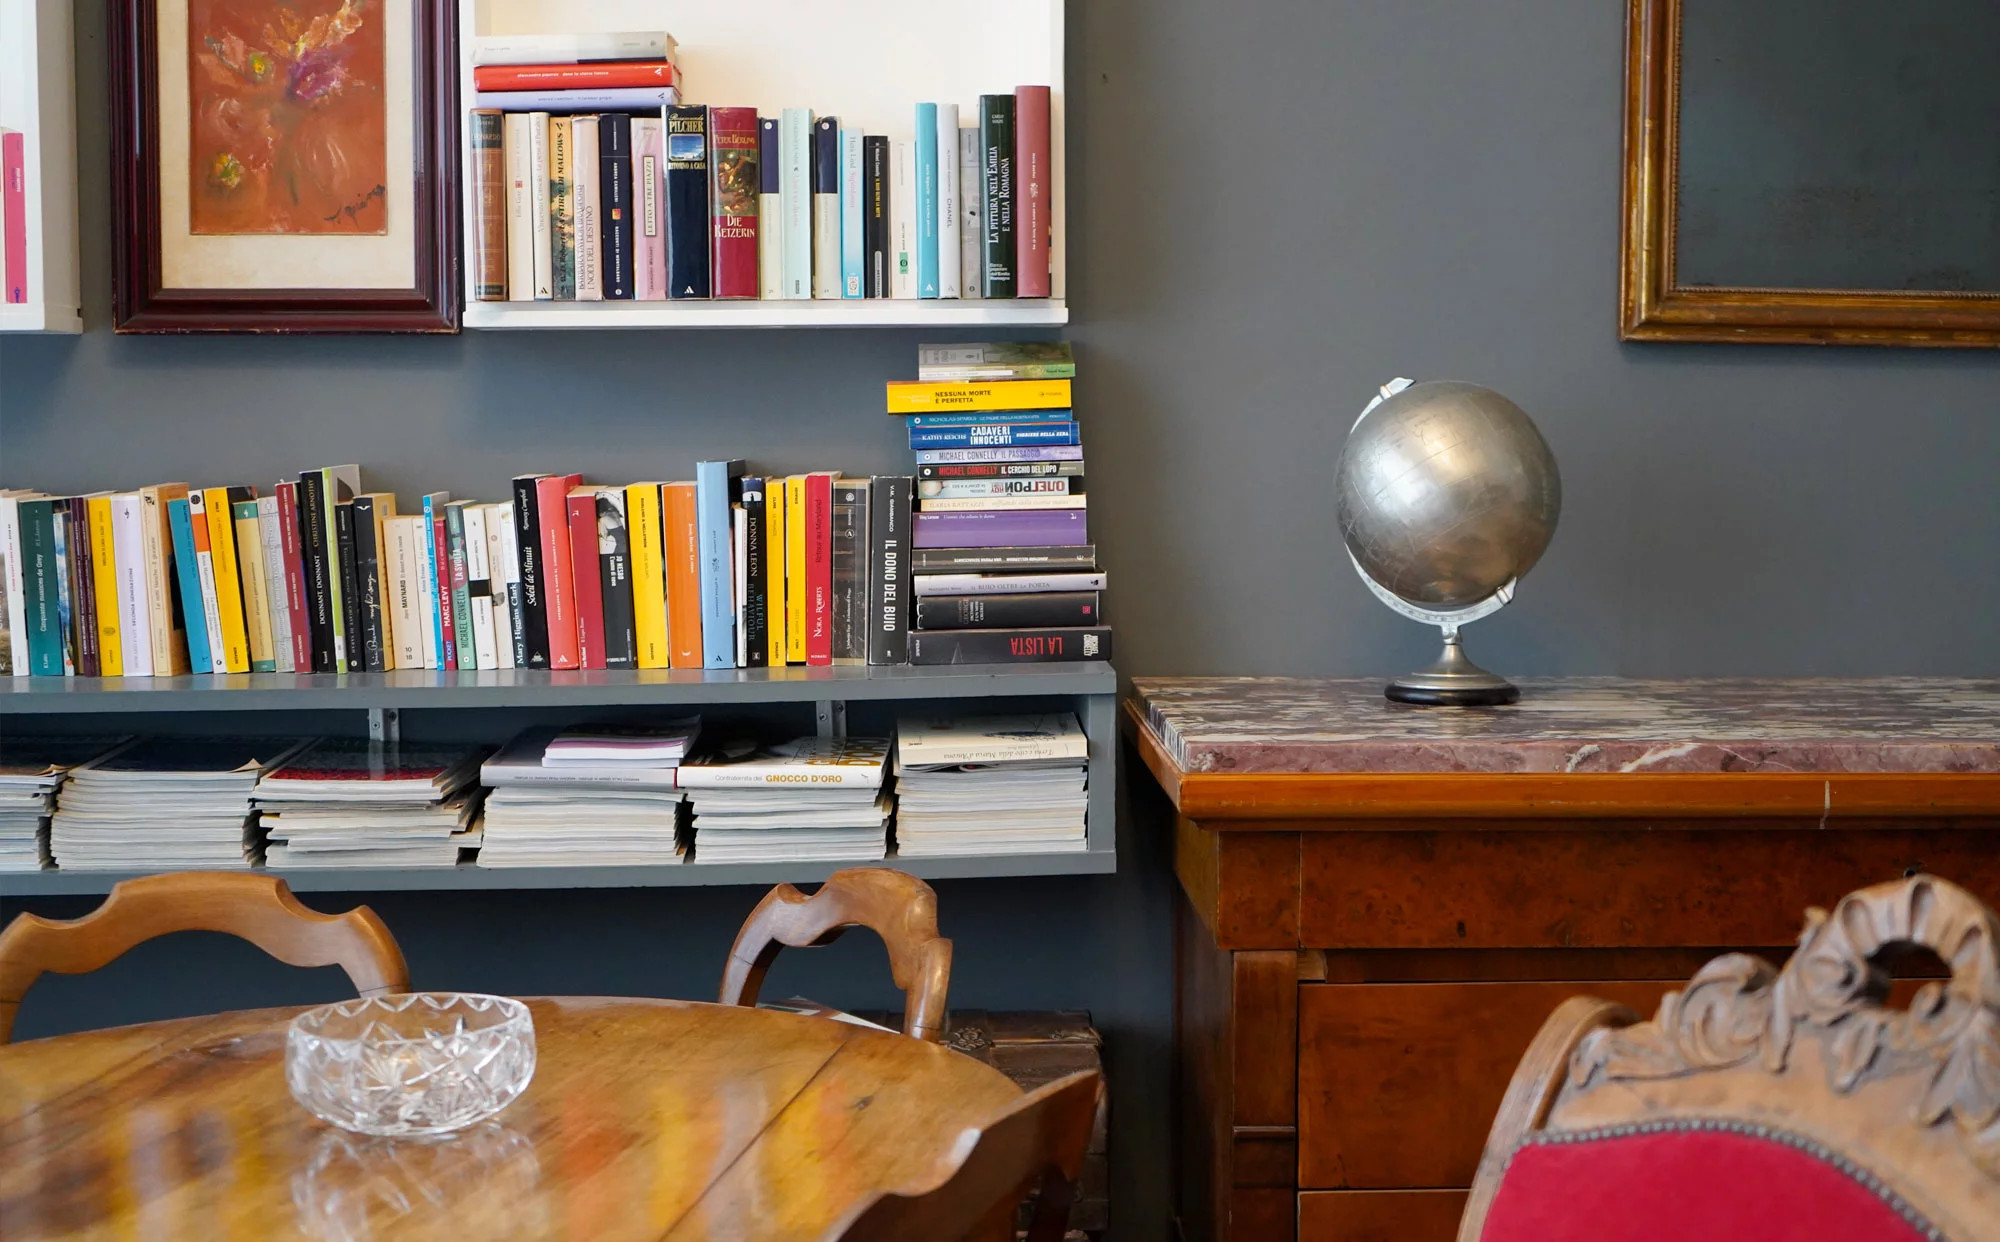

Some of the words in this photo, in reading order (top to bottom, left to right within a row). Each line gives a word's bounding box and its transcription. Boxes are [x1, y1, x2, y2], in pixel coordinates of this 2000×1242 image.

[668, 120, 704, 133] PILCHER
[557, 175, 564, 185] DI
[645, 159, 653, 185] PIAZZE
[986, 146, 998, 195] NELL'EMILIA
[999, 157, 1010, 199] ROMAGNA
[646, 208, 654, 233] LETTO
[727, 213, 743, 227] DIE
[989, 198, 998, 230] PITTURA
[1001, 201, 1010, 224] NELLA
[586, 206, 594, 243] DESTINO
[714, 227, 755, 238] KETZERIN
[988, 233, 999, 244] LA
[587, 264, 595, 284] NODI
[970, 426, 1010, 436] CADAVERI
[970, 435, 1012, 446] INNOCENTI
[938, 451, 965, 461] MICHAEL
[967, 450, 998, 460] CONNELLY
[1001, 450, 1006, 459] IL
[1008, 448, 1041, 459] PASSAGGIO
[938, 466, 964, 476] MICHAEL
[967, 466, 998, 475] CONNELLY
[1001, 465, 1007, 474] IL
[1008, 465, 1030, 474] CERCHIO
[1031, 465, 1043, 474] DEL
[1043, 464, 1057, 473] LUPO
[306, 479, 316, 511] ARNOTHY
[519, 488, 529, 512] Campbell
[814, 499, 823, 531] Maryland
[311, 512, 319, 547] CHRISTINE
[749, 517, 758, 551] DONNA
[815, 532, 822, 541] au
[884, 540, 897, 549] IL
[35, 554, 44, 568] Grey
[453, 548, 463, 572] SVOLTA
[524, 546, 534, 573] Minuit
[750, 553, 758, 577] LEON
[883, 552, 897, 580] DONO
[314, 555, 323, 589] DONNANT
[455, 573, 464, 581] LA
[526, 574, 535, 583] de
[37, 577, 45, 602] nuances
[399, 579, 408, 609] MAYNARD
[441, 586, 449, 605] LEVY
[510, 584, 518, 607] Clark
[527, 585, 537, 606] Soleil
[815, 586, 826, 613] ROBERTS
[883, 583, 897, 603] DEL
[39, 602, 47, 632] Cinquante
[443, 606, 451, 627] MARC
[457, 590, 467, 621] CONNELLY
[747, 583, 755, 641] BEHAVIOUR
[756, 594, 764, 631] WILFUL
[512, 608, 523, 640] Higgins
[813, 616, 823, 638] NORA
[883, 605, 896, 631] BUIO
[460, 622, 469, 649] MICHAEL
[1010, 637, 1044, 656] LISTA
[1048, 637, 1063, 655] LA
[445, 640, 454, 661] POCKET
[515, 643, 525, 664] Mary
[765, 774, 809, 783] GNOCCO
[811, 774, 843, 783] D'ORO
